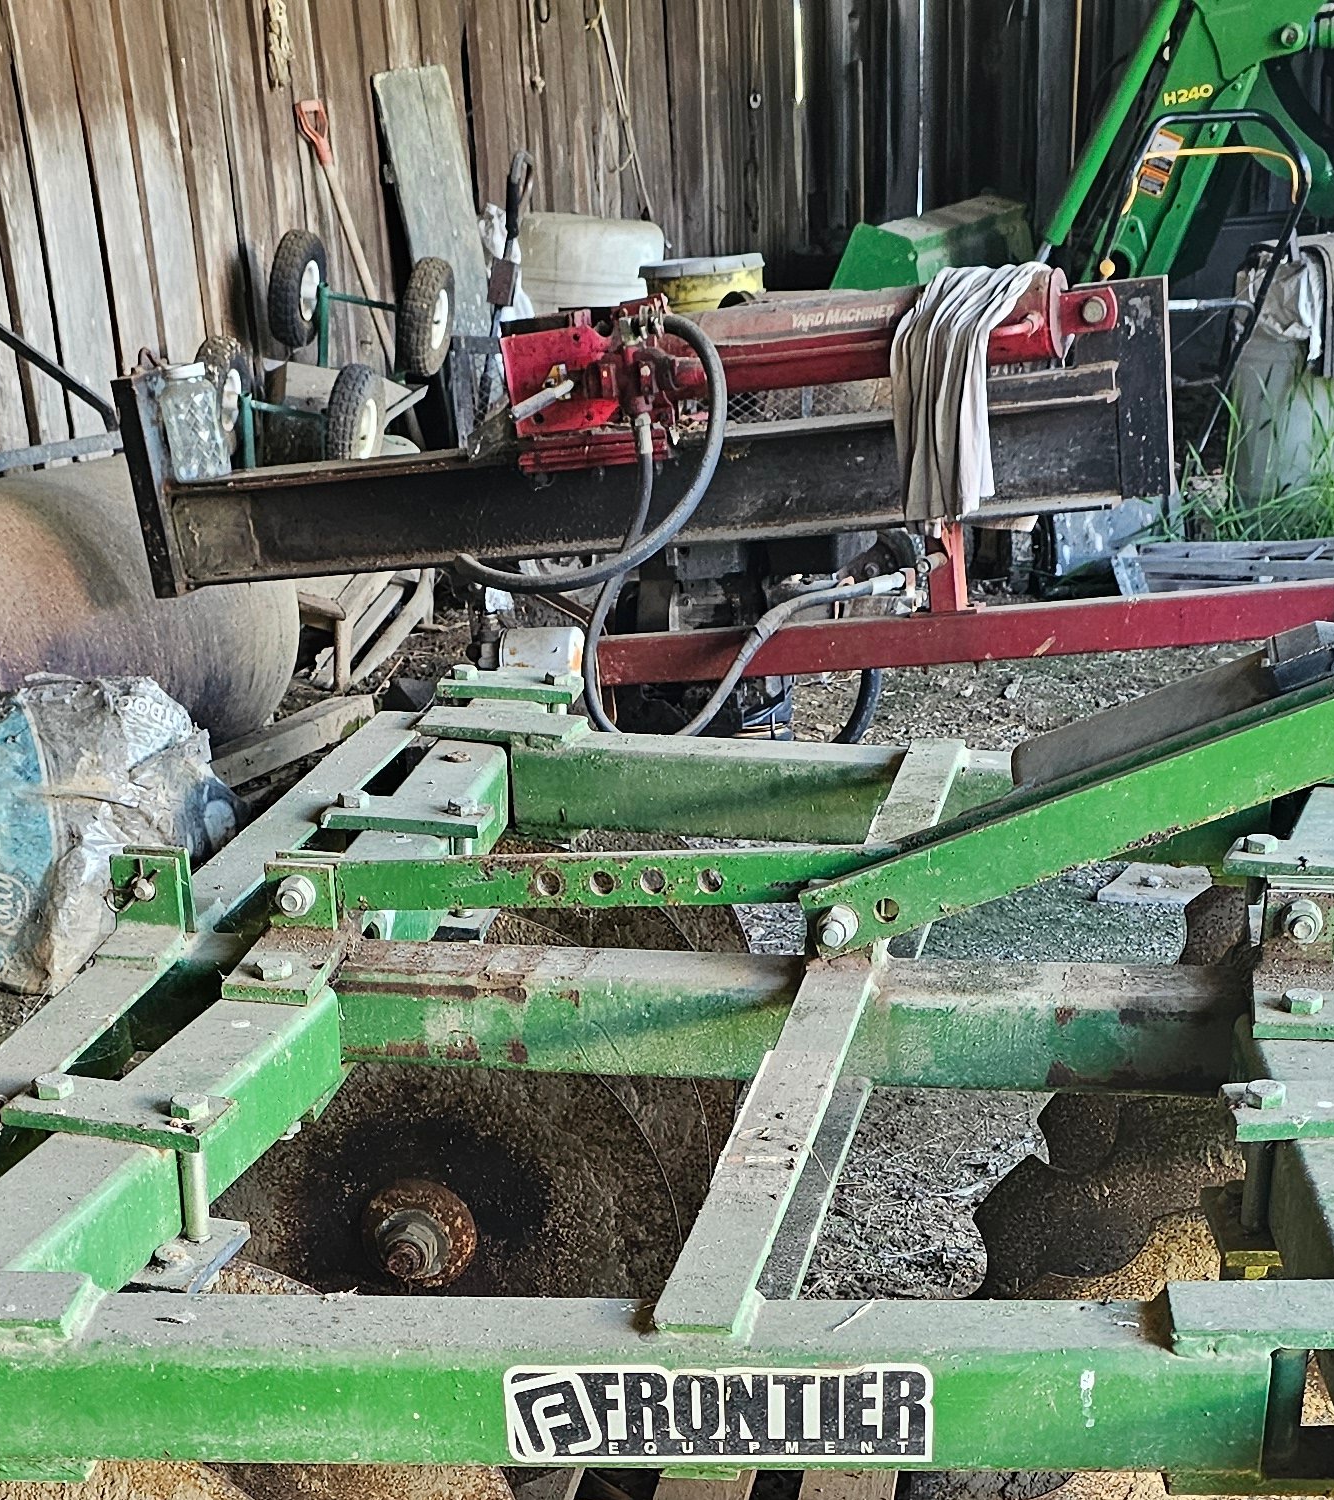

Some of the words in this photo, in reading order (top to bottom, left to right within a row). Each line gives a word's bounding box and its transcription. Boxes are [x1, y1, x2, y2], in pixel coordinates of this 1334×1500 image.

[1163, 83, 1214, 106] H240
[791, 311, 825, 331] YARD
[596, 1370, 928, 1441] FRONTIER
[608, 1441, 910, 1456] EQUIPMENT
